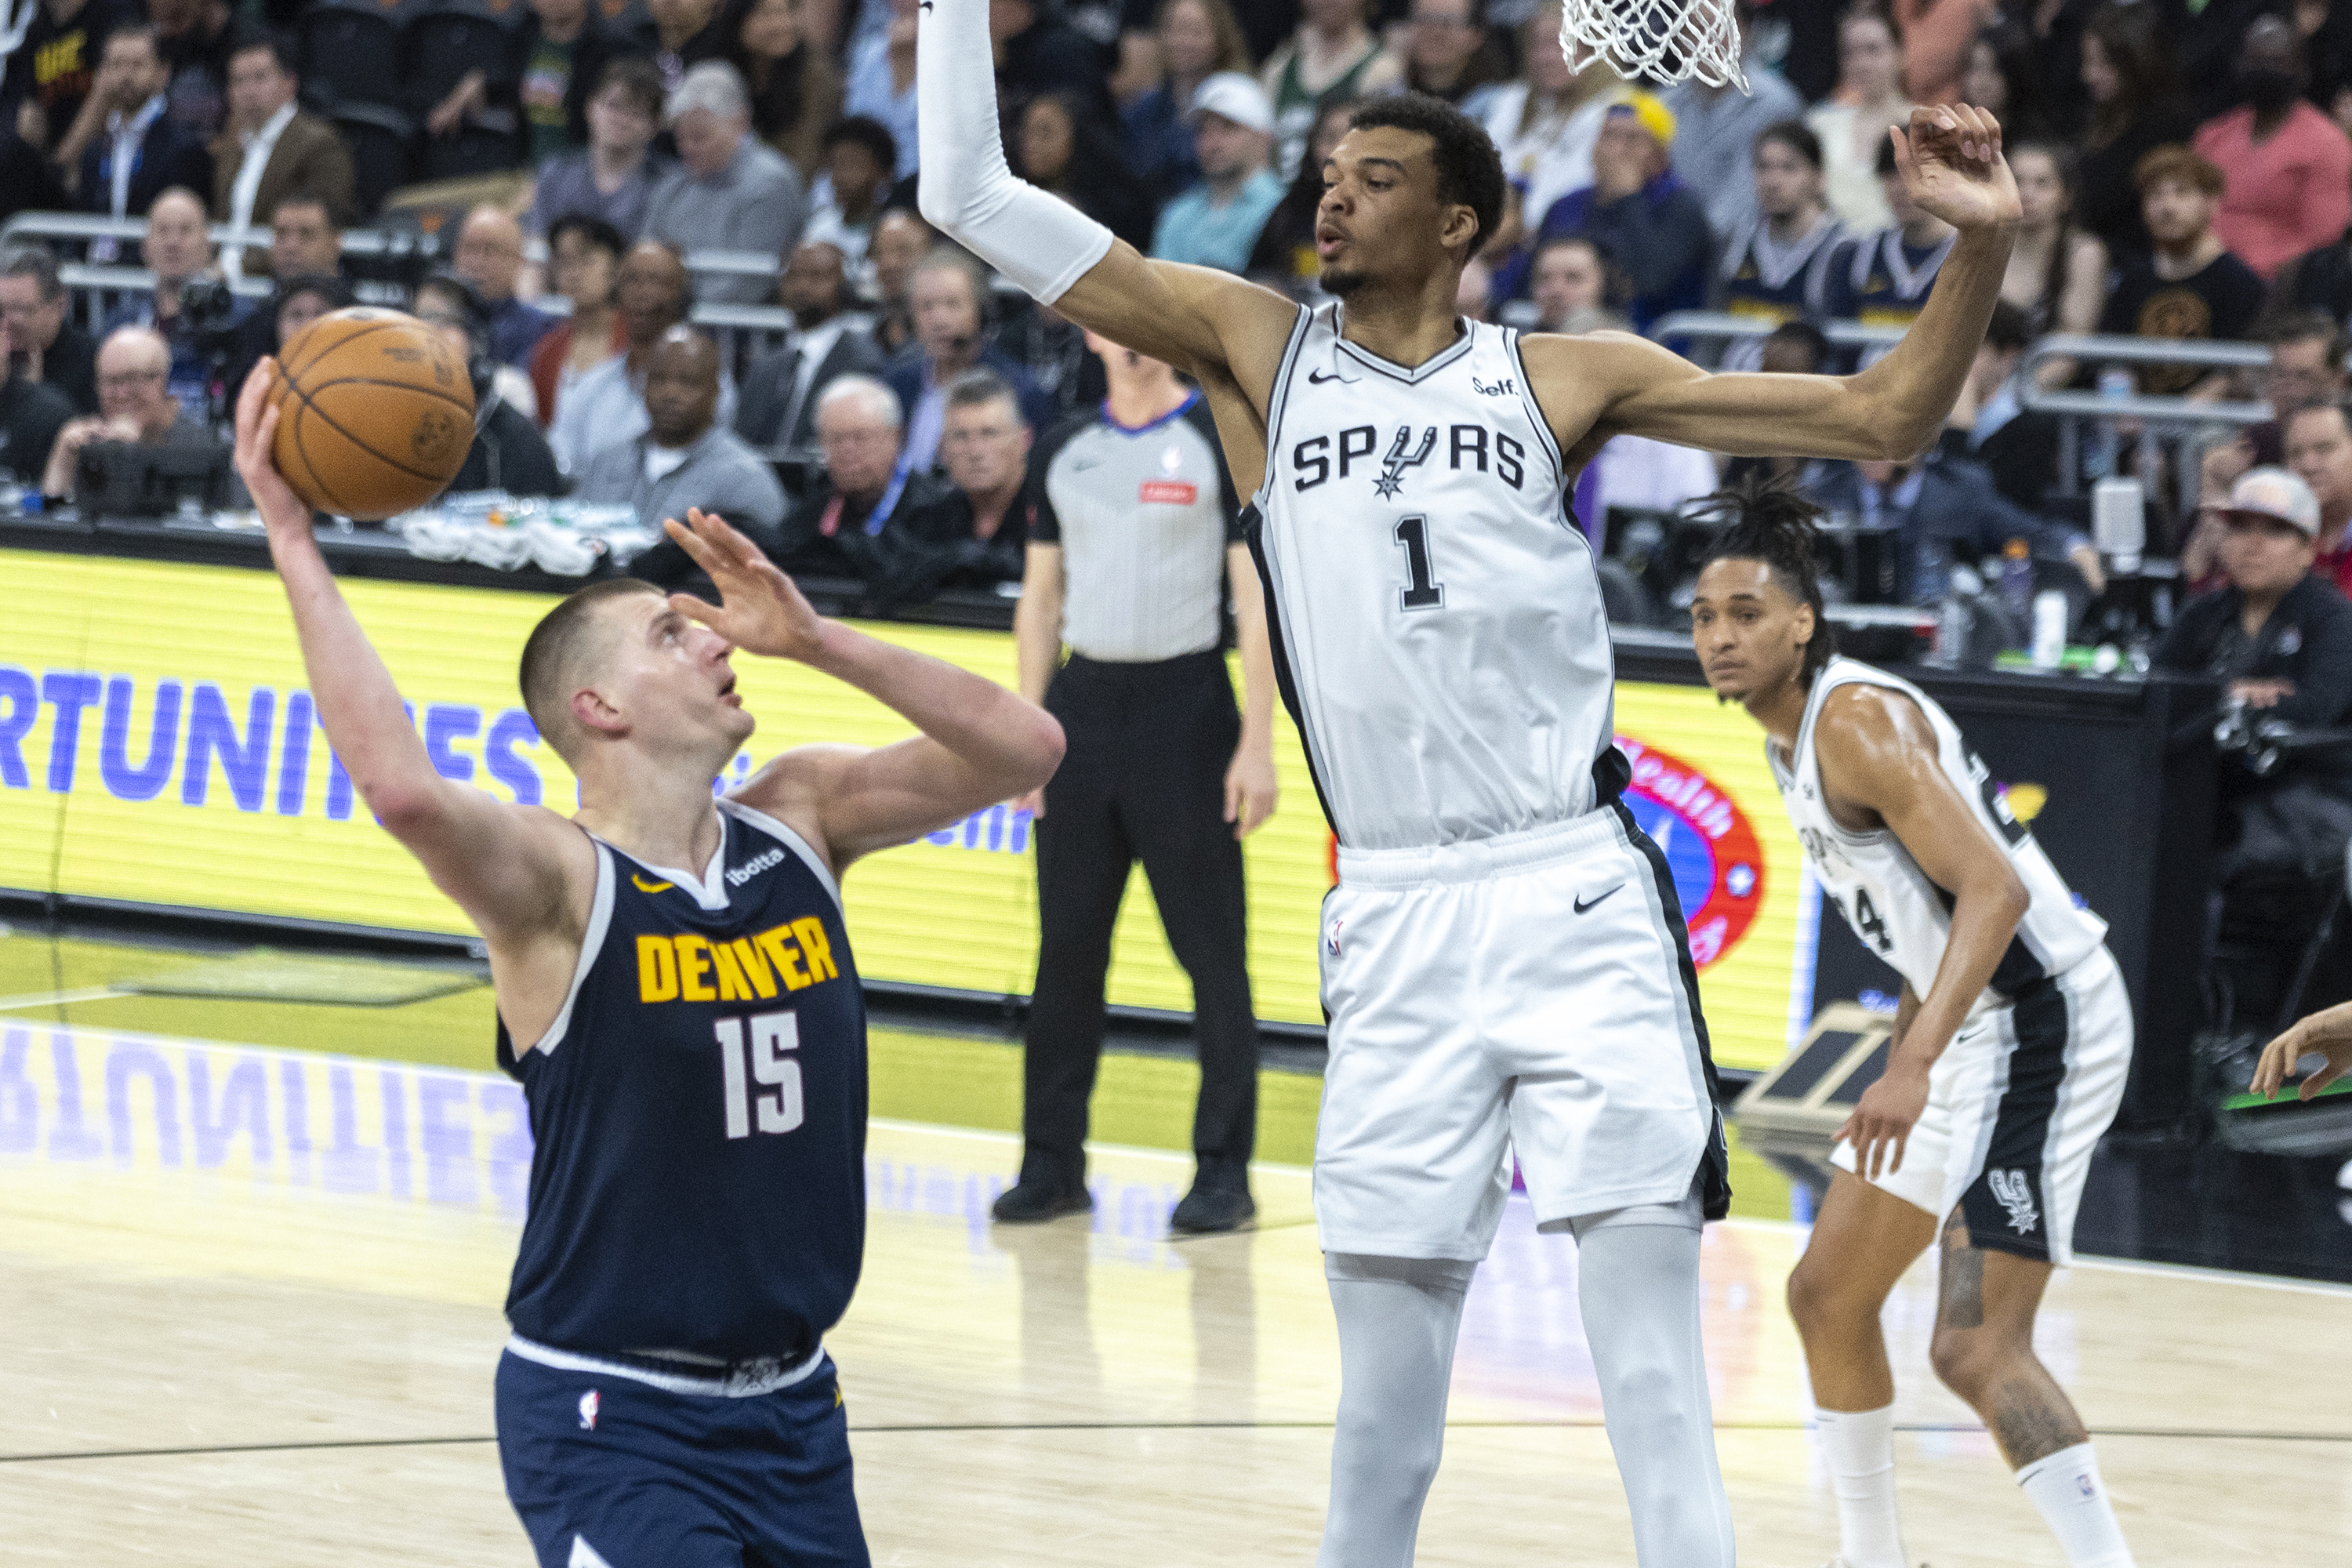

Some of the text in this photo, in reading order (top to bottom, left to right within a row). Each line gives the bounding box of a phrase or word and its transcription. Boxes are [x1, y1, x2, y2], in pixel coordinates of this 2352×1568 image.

[1294, 425, 1526, 502] SPURS
[1393, 514, 1445, 612] 1
[725, 848, 785, 887] ibotta
[636, 916, 839, 1004] DENVER
[714, 1010, 804, 1140] 15
